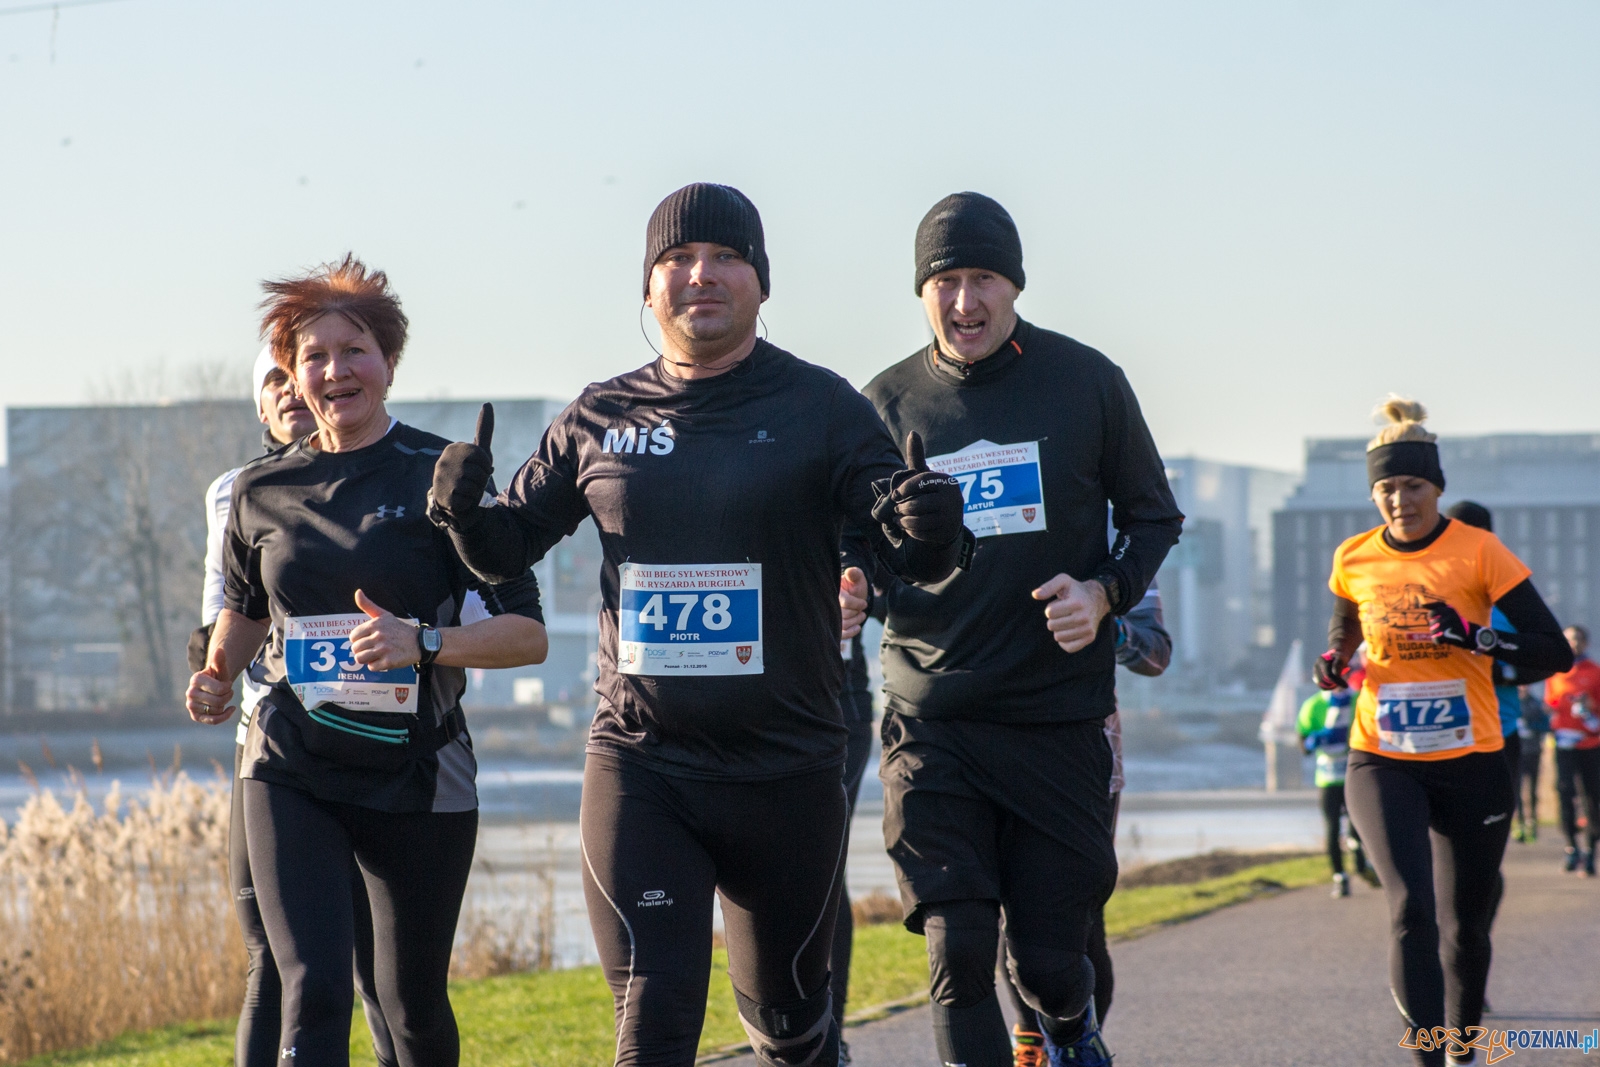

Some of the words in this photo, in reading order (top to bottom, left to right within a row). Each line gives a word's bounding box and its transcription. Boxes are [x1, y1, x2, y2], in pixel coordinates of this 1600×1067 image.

[602, 419, 675, 456] MiŚ
[953, 456, 970, 464] BIEG
[972, 447, 1029, 460] SYLWESTROWY
[948, 461, 986, 473] RYSZARDA
[988, 456, 1026, 466] BURGIELA
[967, 500, 995, 511] ARTUR
[654, 570, 676, 578] BIEG
[678, 569, 750, 578] SYLWESTROWY
[698, 580, 746, 588] BURGIELA
[638, 593, 732, 631] 478
[310, 641, 388, 672] 33
[1393, 699, 1454, 725] 172
[637, 898, 674, 907] Kalenji
